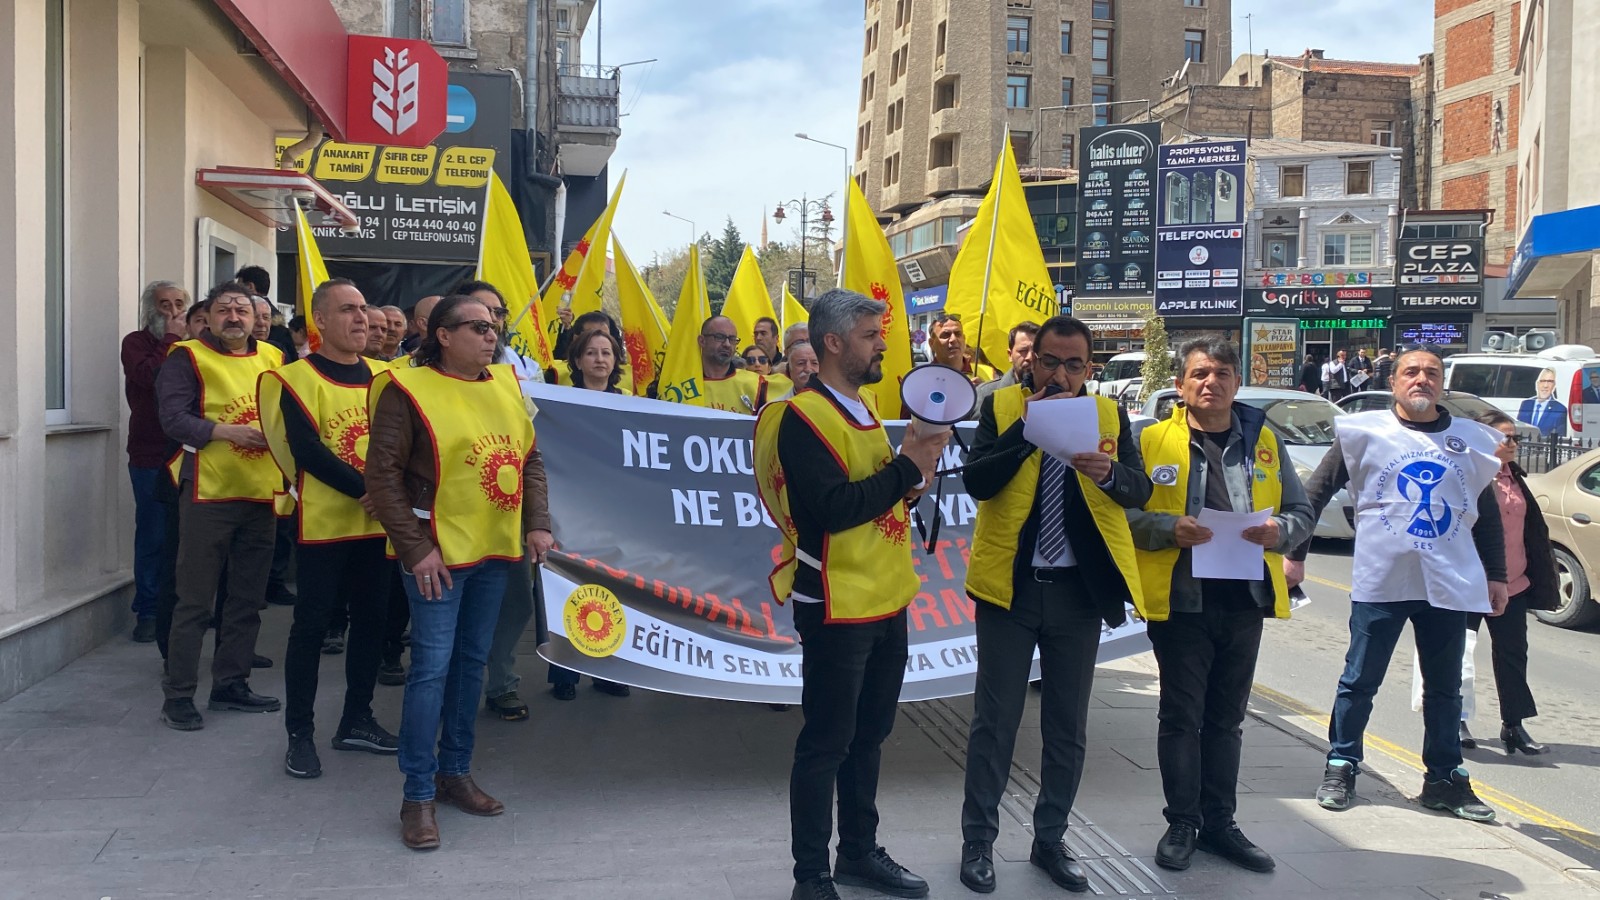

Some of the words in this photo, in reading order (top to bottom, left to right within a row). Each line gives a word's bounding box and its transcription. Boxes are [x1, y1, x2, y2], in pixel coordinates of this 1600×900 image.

[323, 149, 370, 160] ANAKART
[1090, 143, 1115, 160] halis
[1169, 145, 1236, 156] PROFESYONEL
[385, 152, 408, 162] SIFIR
[411, 153, 428, 161] CEP
[446, 155, 455, 163] 2.
[457, 155, 467, 164] EL
[469, 156, 487, 165] CEP
[330, 163, 364, 174] TAMİRİ
[385, 165, 429, 176] TELEFONU
[445, 168, 489, 179] TELEFONU
[395, 194, 477, 216] İLETİŞİM
[365, 217, 380, 227] 94
[391, 218, 420, 229] 0544
[422, 219, 443, 230] 440
[446, 221, 460, 231] 40
[462, 221, 476, 232] 40
[392, 230, 408, 240] CEP
[409, 231, 452, 242] TELEFONU
[453, 233, 475, 245] SATIŞ
[1159, 230, 1231, 242] TELEFONCU
[1408, 244, 1472, 260] CEP
[1403, 262, 1476, 273] PLAZA
[1340, 290, 1368, 298] Mobile
[1074, 302, 1112, 311] Osmanlı
[1158, 301, 1198, 310] APPLE
[1401, 296, 1477, 306] TELEFONCU
[218, 392, 257, 423] EĞİTİ
[464, 432, 511, 467] EĞİTİM
[621, 428, 671, 471] NE
[1378, 458, 1400, 488] SOSYAL
[671, 488, 723, 527] NE
[1413, 541, 1433, 551] SES
[570, 587, 609, 607] EĞİTİM
[610, 601, 623, 625] SEN
[631, 622, 715, 670] EĞİTİM
[722, 653, 771, 677] SEN
